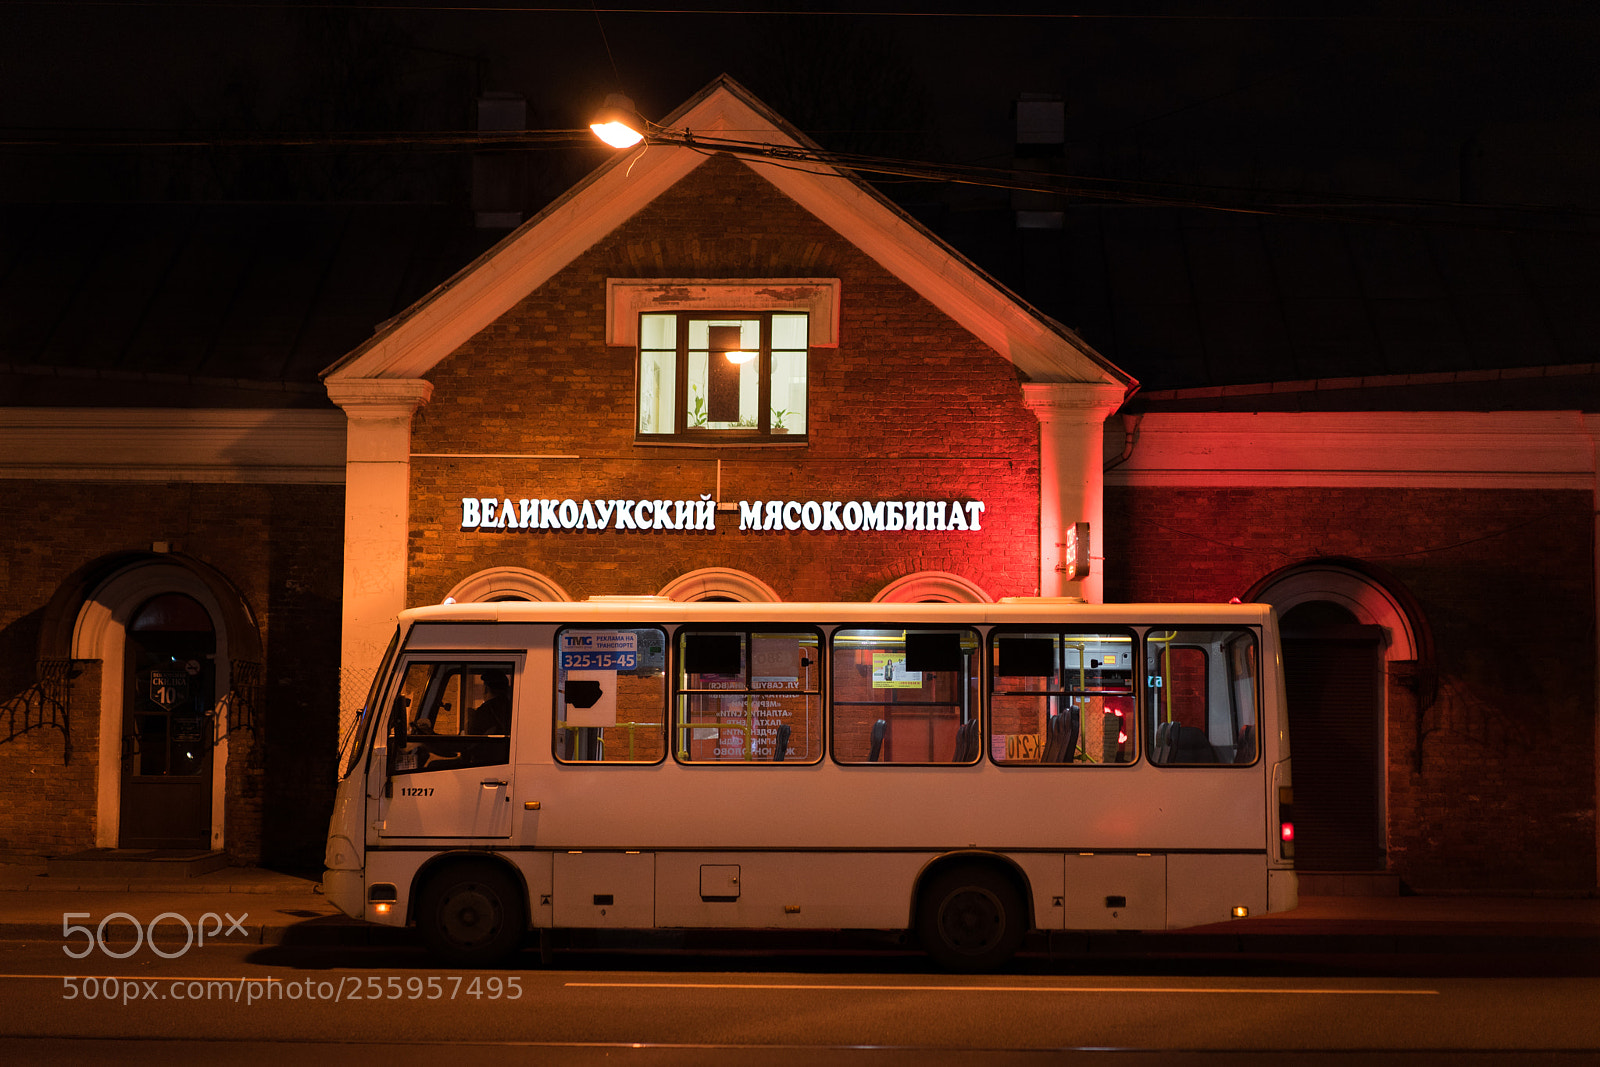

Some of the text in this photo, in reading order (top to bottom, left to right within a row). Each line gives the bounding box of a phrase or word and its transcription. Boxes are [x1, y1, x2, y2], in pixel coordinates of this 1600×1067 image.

[461, 494, 985, 532] ВЕЛИКОЛУКСКИЙ МЯСОКОМБИНАТ
[564, 636, 593, 646] TMG
[564, 654, 635, 667] 325-15-45
[401, 787, 435, 797] 112217
